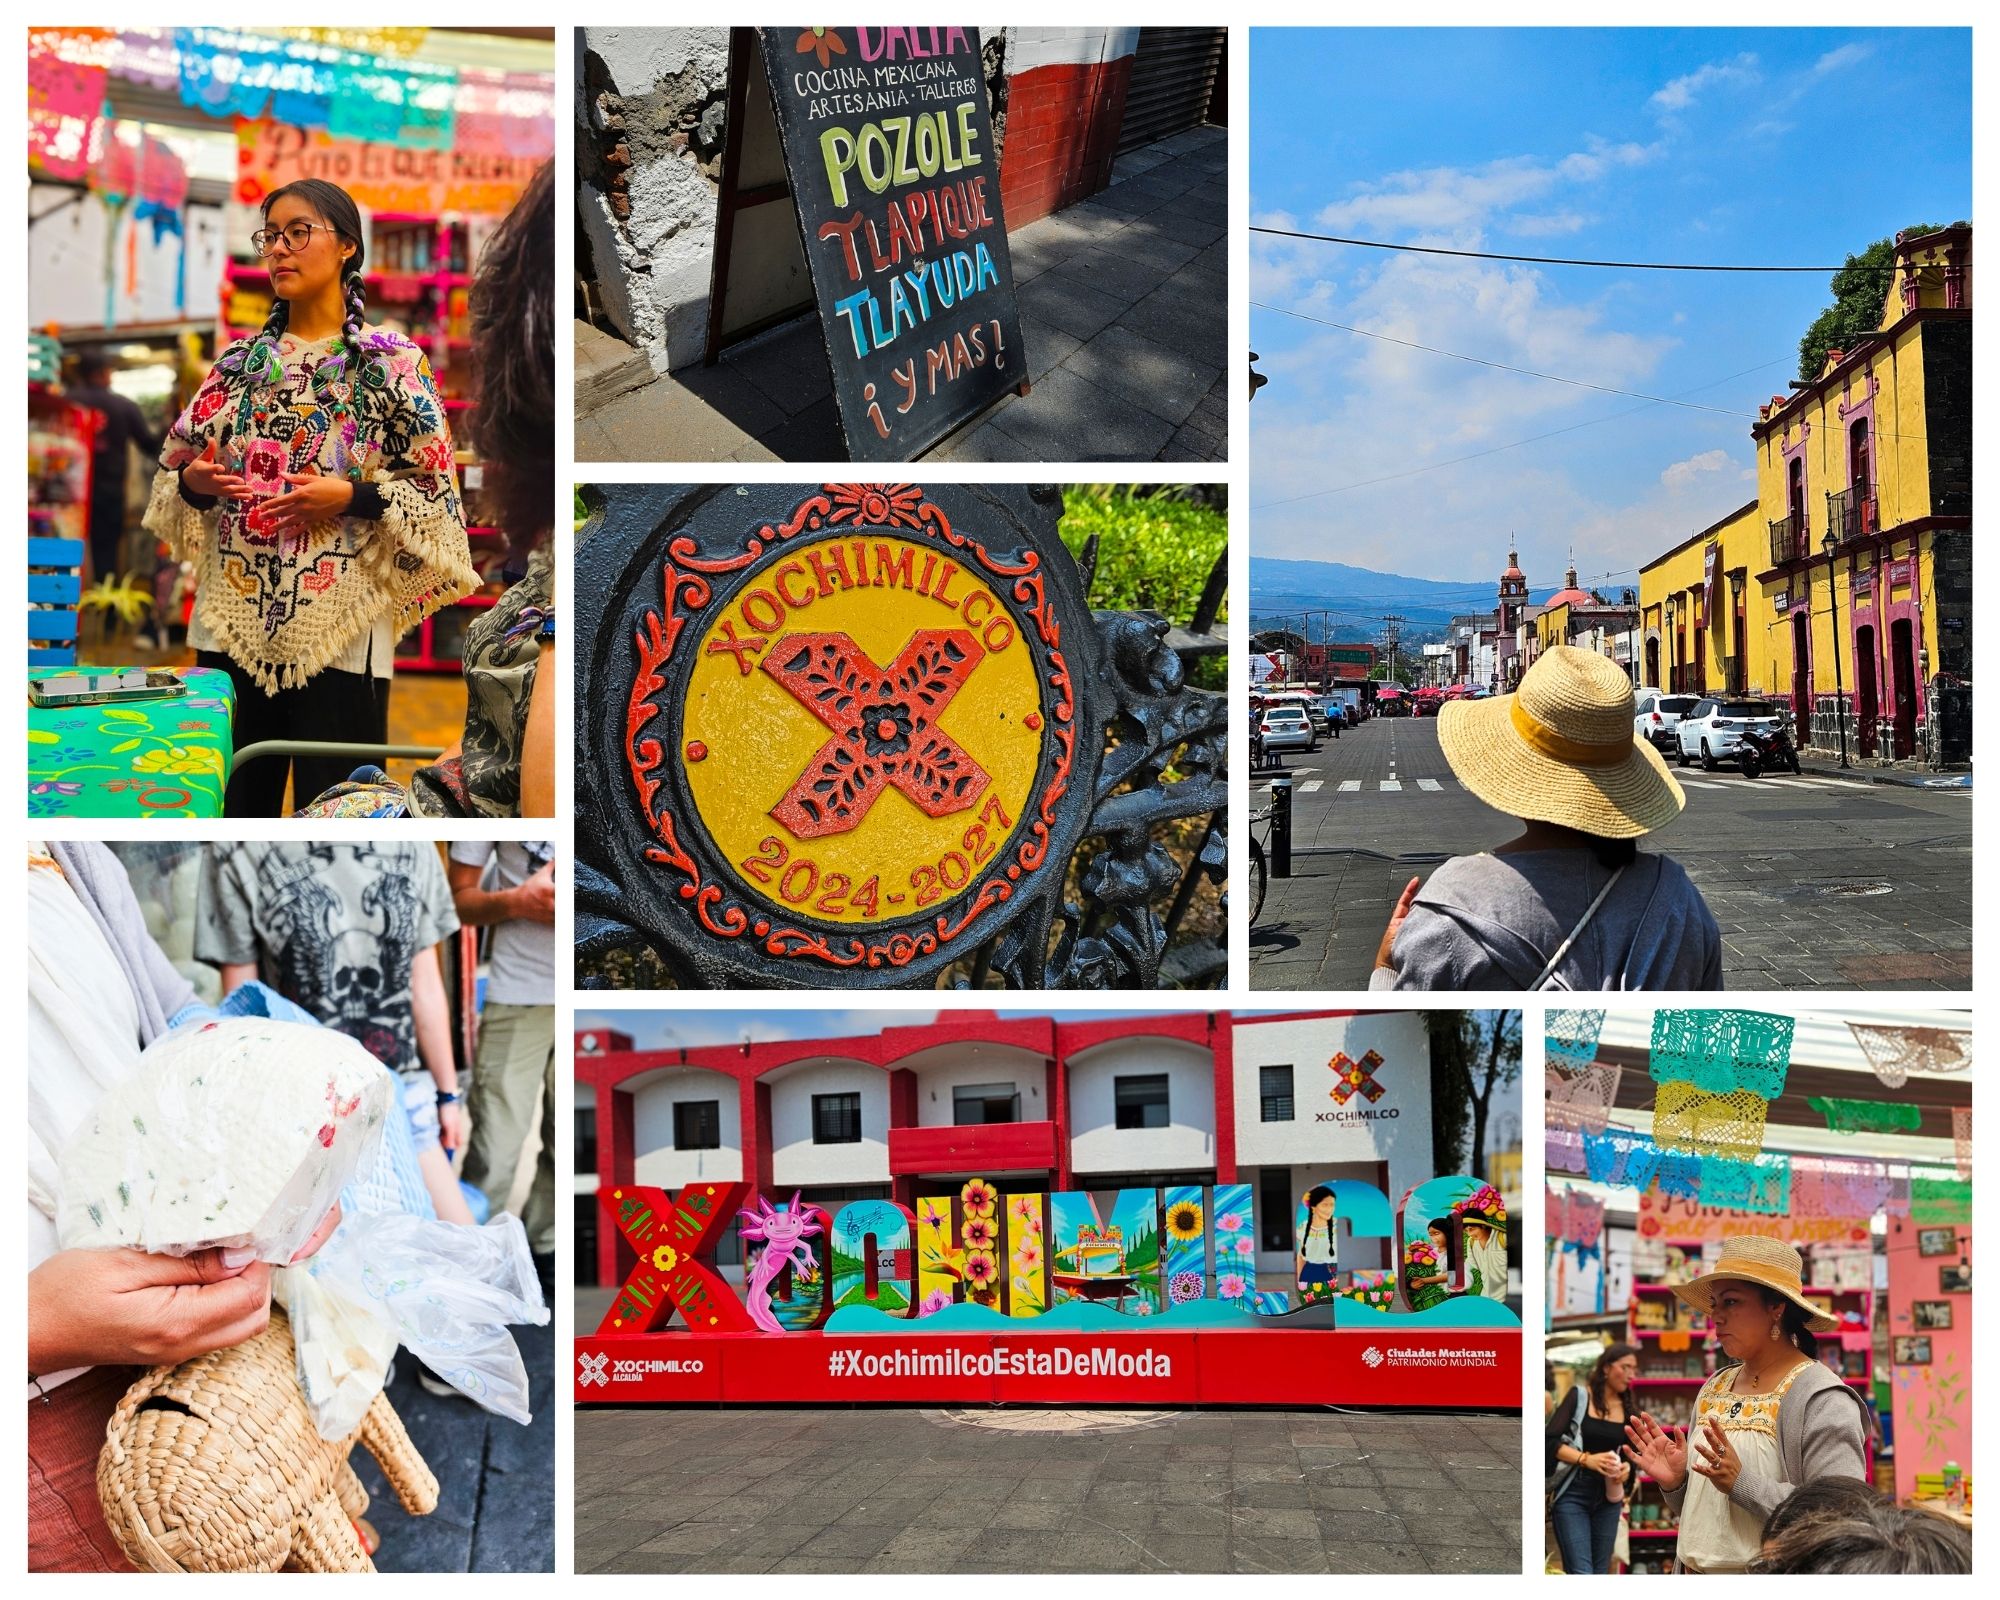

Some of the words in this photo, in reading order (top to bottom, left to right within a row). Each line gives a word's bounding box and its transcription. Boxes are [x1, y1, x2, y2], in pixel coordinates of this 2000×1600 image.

[794, 67, 871, 97] COCINA
[874, 61, 958, 88] MEXICANA
[807, 89, 910, 121] ARTESANIA
[916, 77, 978, 101] TALLERES
[818, 101, 983, 209] POZOLE
[817, 175, 994, 281] TLAPIQUE
[834, 241, 1001, 360] TLAYUDA
[707, 541, 1015, 675] XOCHIMILCO
[741, 793, 1013, 917] 2024-2027
[1315, 1108, 1400, 1123] XOCHIMILCO
[612, 1360, 704, 1373] XOCHIMILCO
[828, 1347, 1172, 1377] #XochimilcoEstaDeModa
[1386, 1348, 1437, 1358] Ciudades
[1438, 1348, 1497, 1358] Mexicanas
[1387, 1358, 1448, 1367] PATRIMONIO
[1449, 1358, 1498, 1367] MUNDIAL
[612, 1371, 643, 1382] ALCALDÍA
